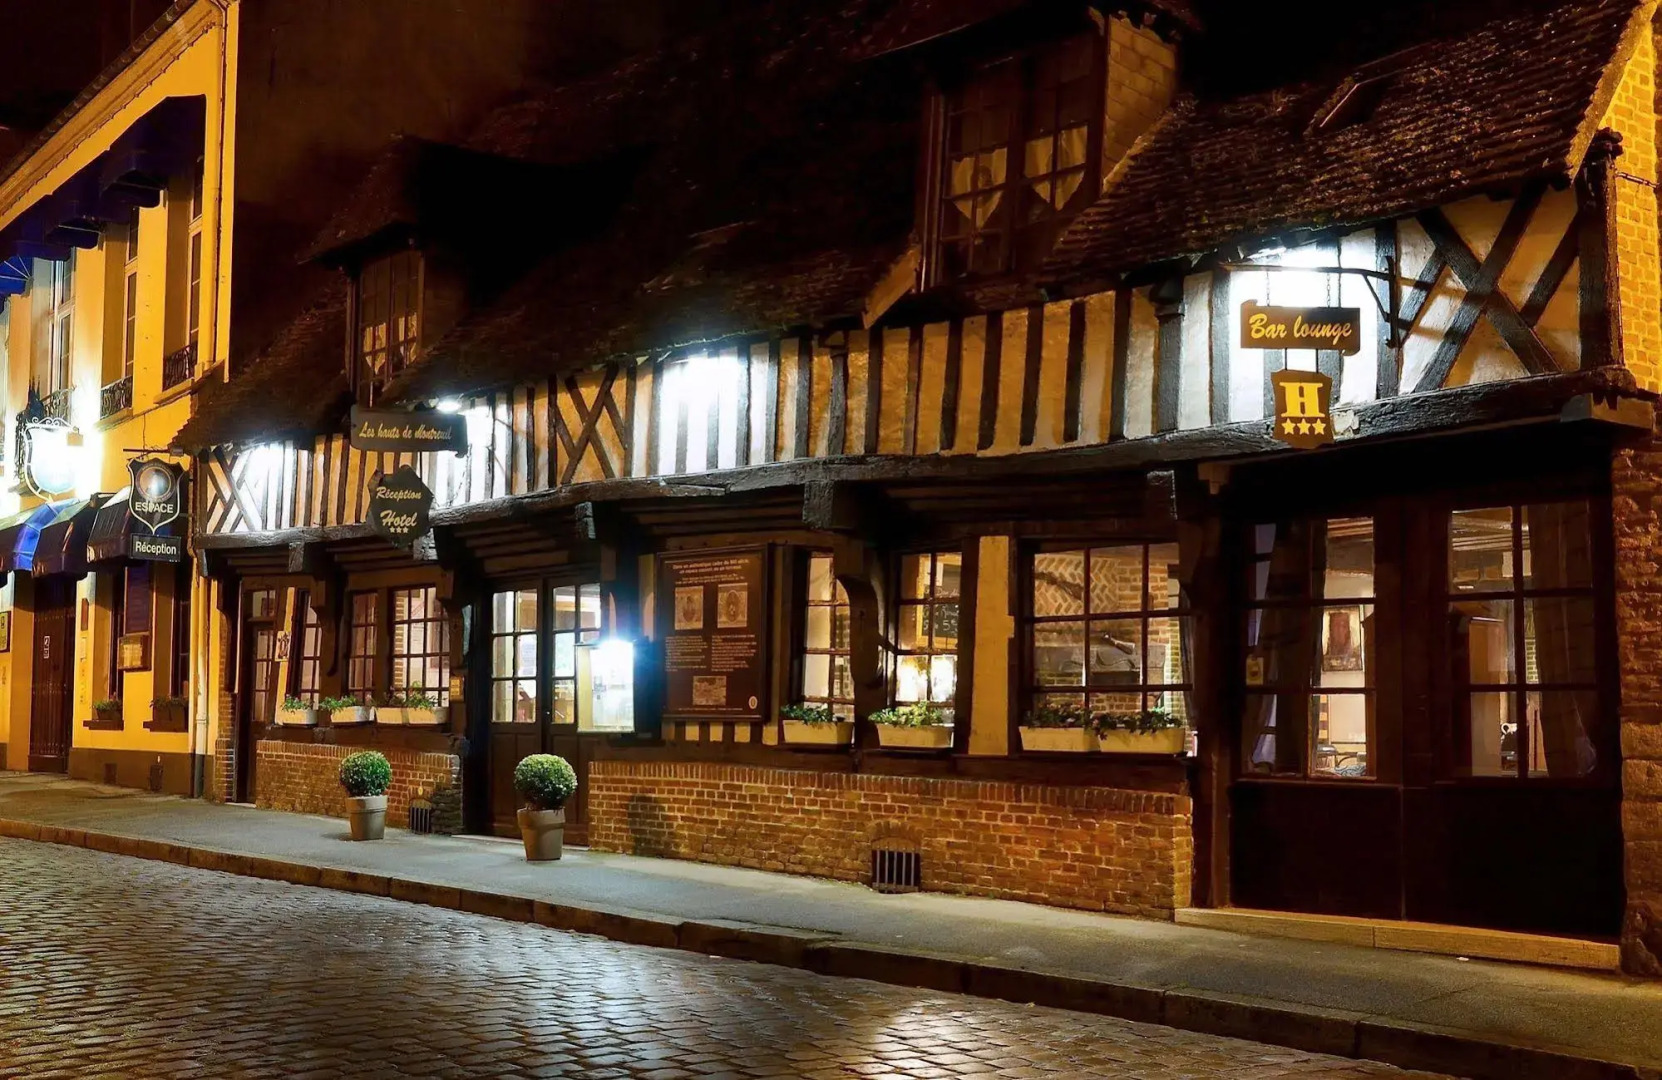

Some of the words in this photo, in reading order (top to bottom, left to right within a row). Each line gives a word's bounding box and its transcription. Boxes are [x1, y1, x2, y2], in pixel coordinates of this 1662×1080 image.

[1249, 313, 1287, 339] Bar
[1293, 315, 1352, 345] lounge
[1279, 382, 1325, 417] H
[359, 421, 375, 438] Les
[378, 423, 400, 439] hauts
[402, 426, 412, 439] de
[376, 486, 422, 502] Réception
[135, 501, 174, 514] ESPACE
[380, 510, 417, 527] Hotel
[135, 541, 177, 555] Réception
